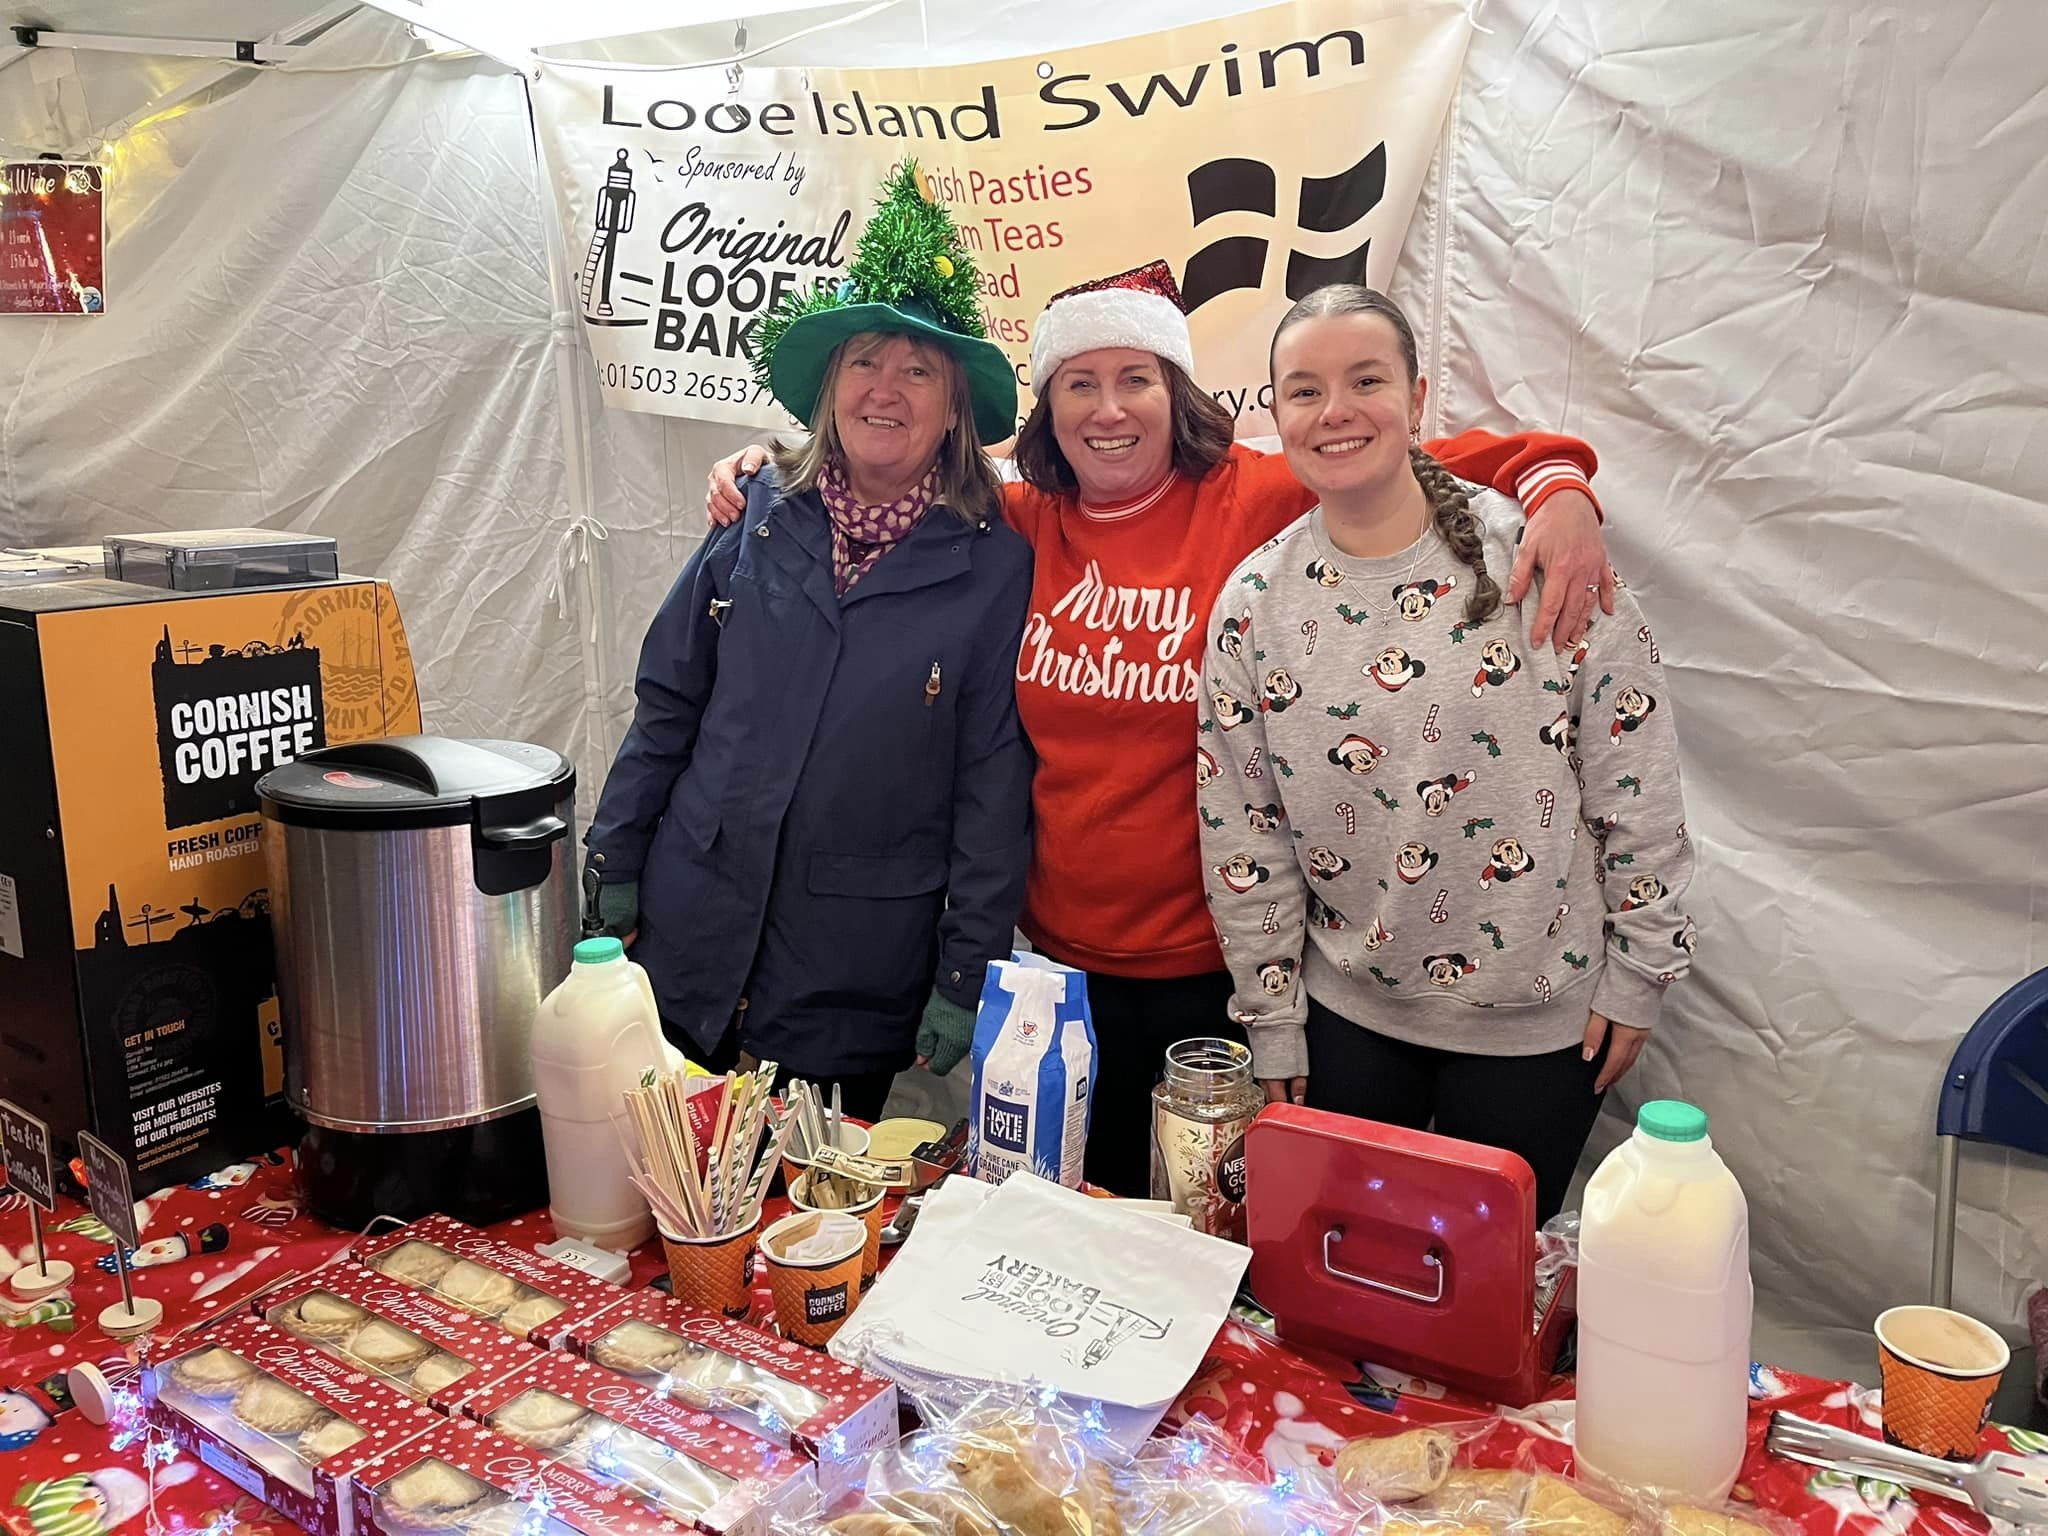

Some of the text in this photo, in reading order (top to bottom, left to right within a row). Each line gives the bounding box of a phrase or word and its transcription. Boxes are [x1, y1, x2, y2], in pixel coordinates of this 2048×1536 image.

[602, 29, 1365, 141] Looe Island Swim
[678, 146, 806, 196] Sponsored by
[968, 164, 1093, 205] Pasties
[660, 202, 851, 280] Original
[984, 218, 1064, 252] Teas
[661, 261, 796, 314] LOOE
[974, 263, 1020, 299] ead
[654, 308, 757, 359] BAK
[1051, 559, 1196, 661] Merry
[1016, 612, 1201, 703] Christmas
[171, 684, 313, 739] CORNISH
[175, 722, 314, 785] COFFEE
[168, 822, 263, 857] FRESH COFF
[169, 840, 259, 872] HAND ROASTED
[124, 1019, 185, 1048] GET IN TOUCH
[132, 1105, 156, 1122] VISIT
[157, 1098, 176, 1112] OUR
[177, 1081, 222, 1105] WEBSITES
[133, 1097, 216, 1136] FOR MORE DETAILS
[988, 1105, 1023, 1128] TATE
[135, 1108, 217, 1148] ON OUR PRODUCTS!
[990, 1120, 1022, 1142] LYLE
[979, 1157, 1013, 1179] GRANULA
[985, 1151, 1020, 1171] PURE CANE
[454, 1238, 558, 1281] Christmas
[501, 1245, 540, 1262] MERRY
[809, 1291, 846, 1307] CORNISH
[986, 1255, 1101, 1305] BAKERY
[361, 1289, 468, 1340] Christmas
[410, 1297, 451, 1316] MERRY
[809, 1299, 845, 1317] COFFEE
[680, 1317, 804, 1371] Christmas
[731, 1326, 778, 1346] MERRY
[255, 1345, 363, 1403] Christmas
[305, 1355, 349, 1377] MERRY
[586, 1385, 717, 1449] Christmas
[644, 1397, 691, 1419] MERRY
[542, 1467, 595, 1495] MERRY
